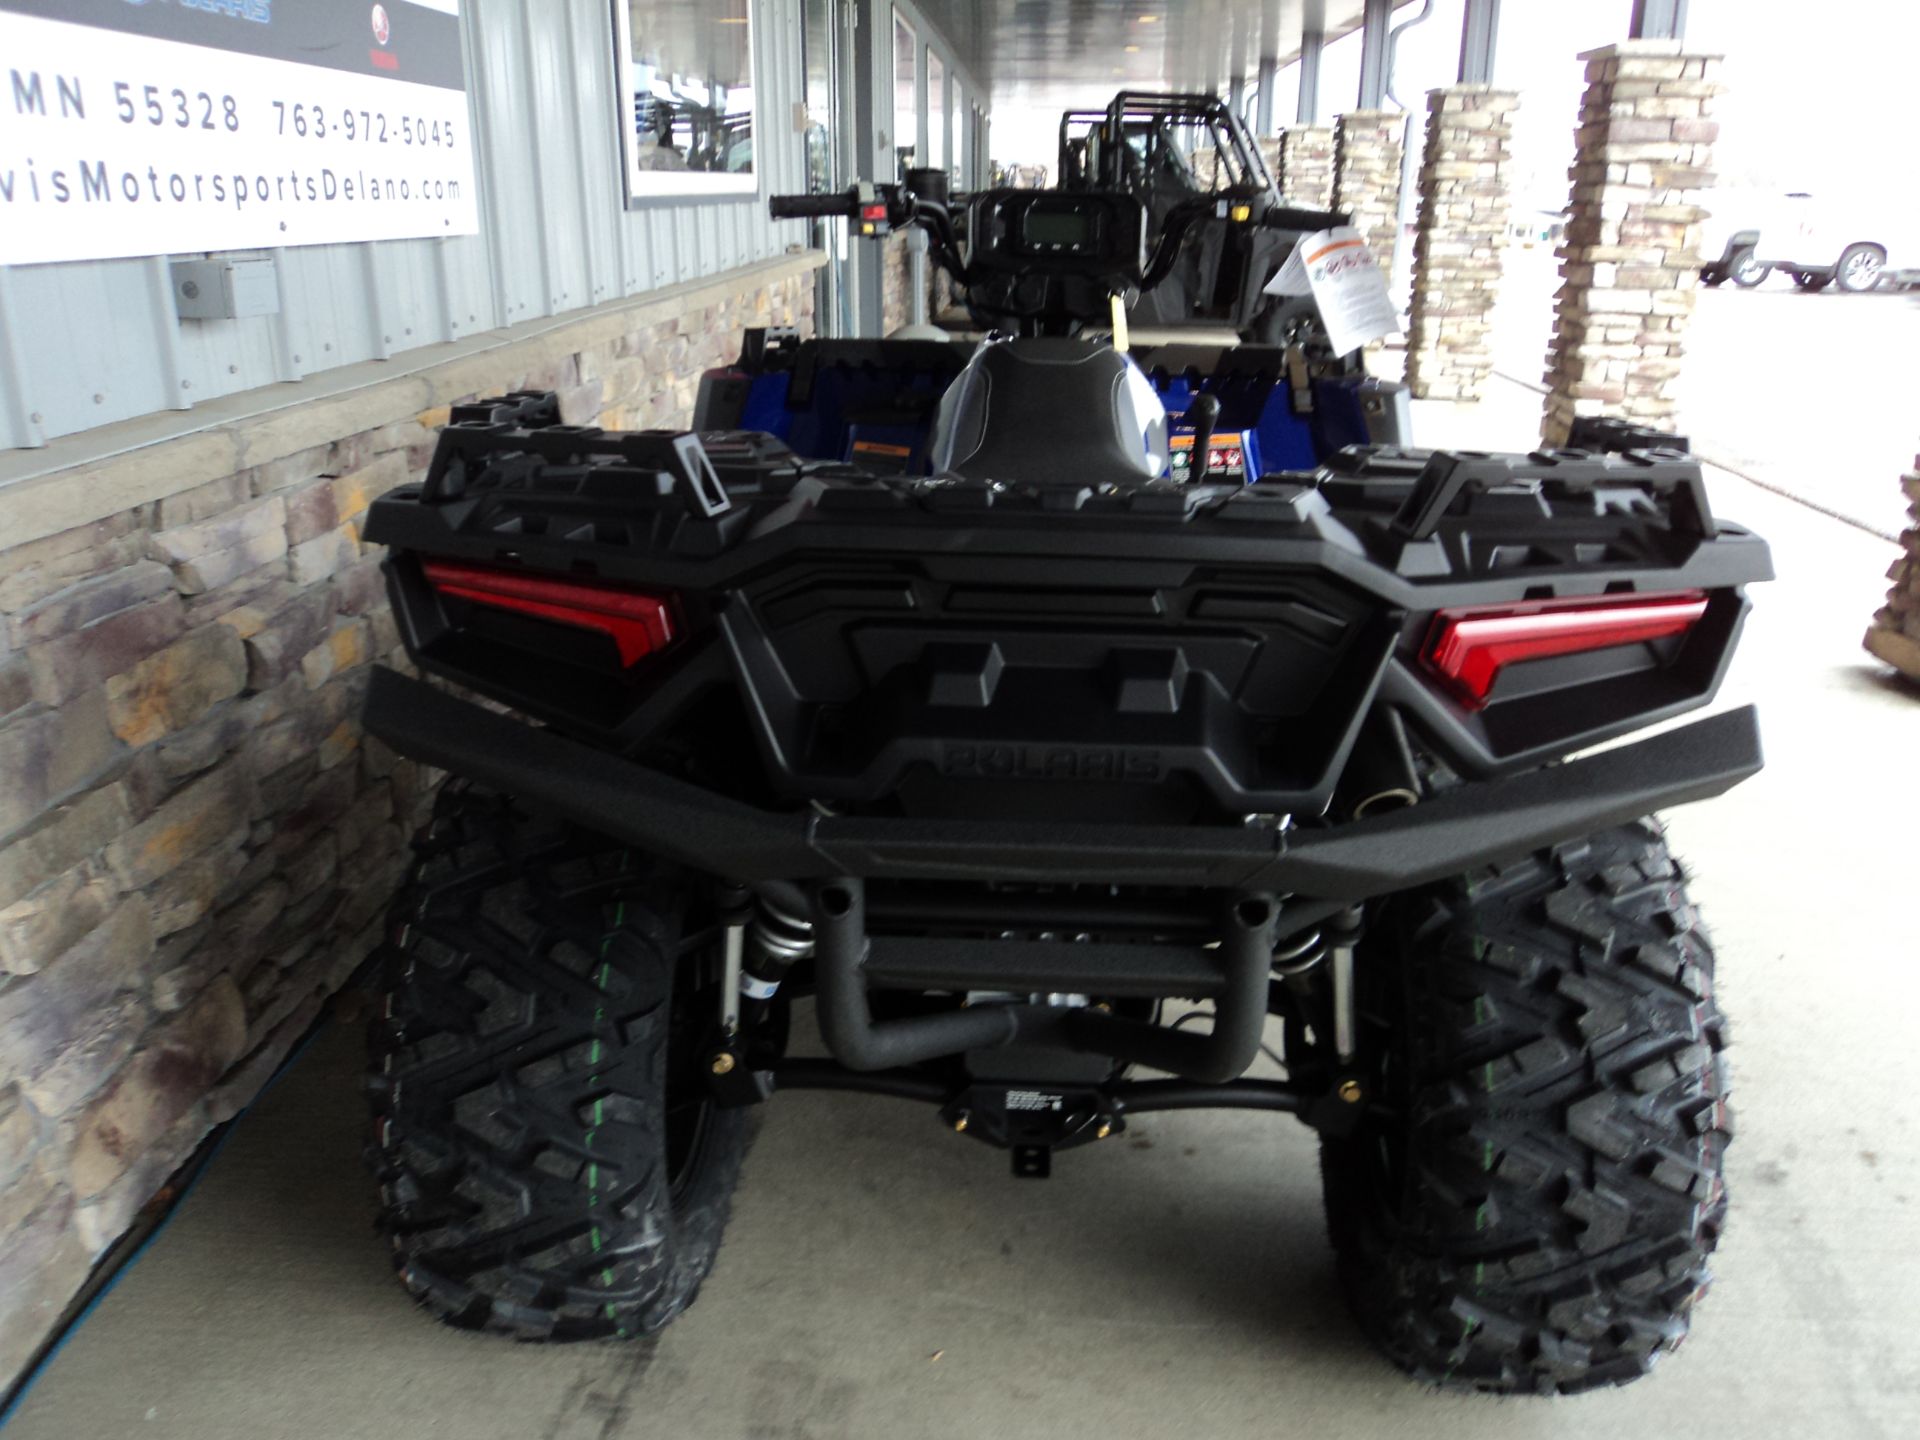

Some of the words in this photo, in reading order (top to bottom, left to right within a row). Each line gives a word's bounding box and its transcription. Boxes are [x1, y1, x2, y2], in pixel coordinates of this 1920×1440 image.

[10, 69, 86, 119] MN
[113, 81, 240, 132] 55328
[943, 745, 1162, 782] POLARIS
